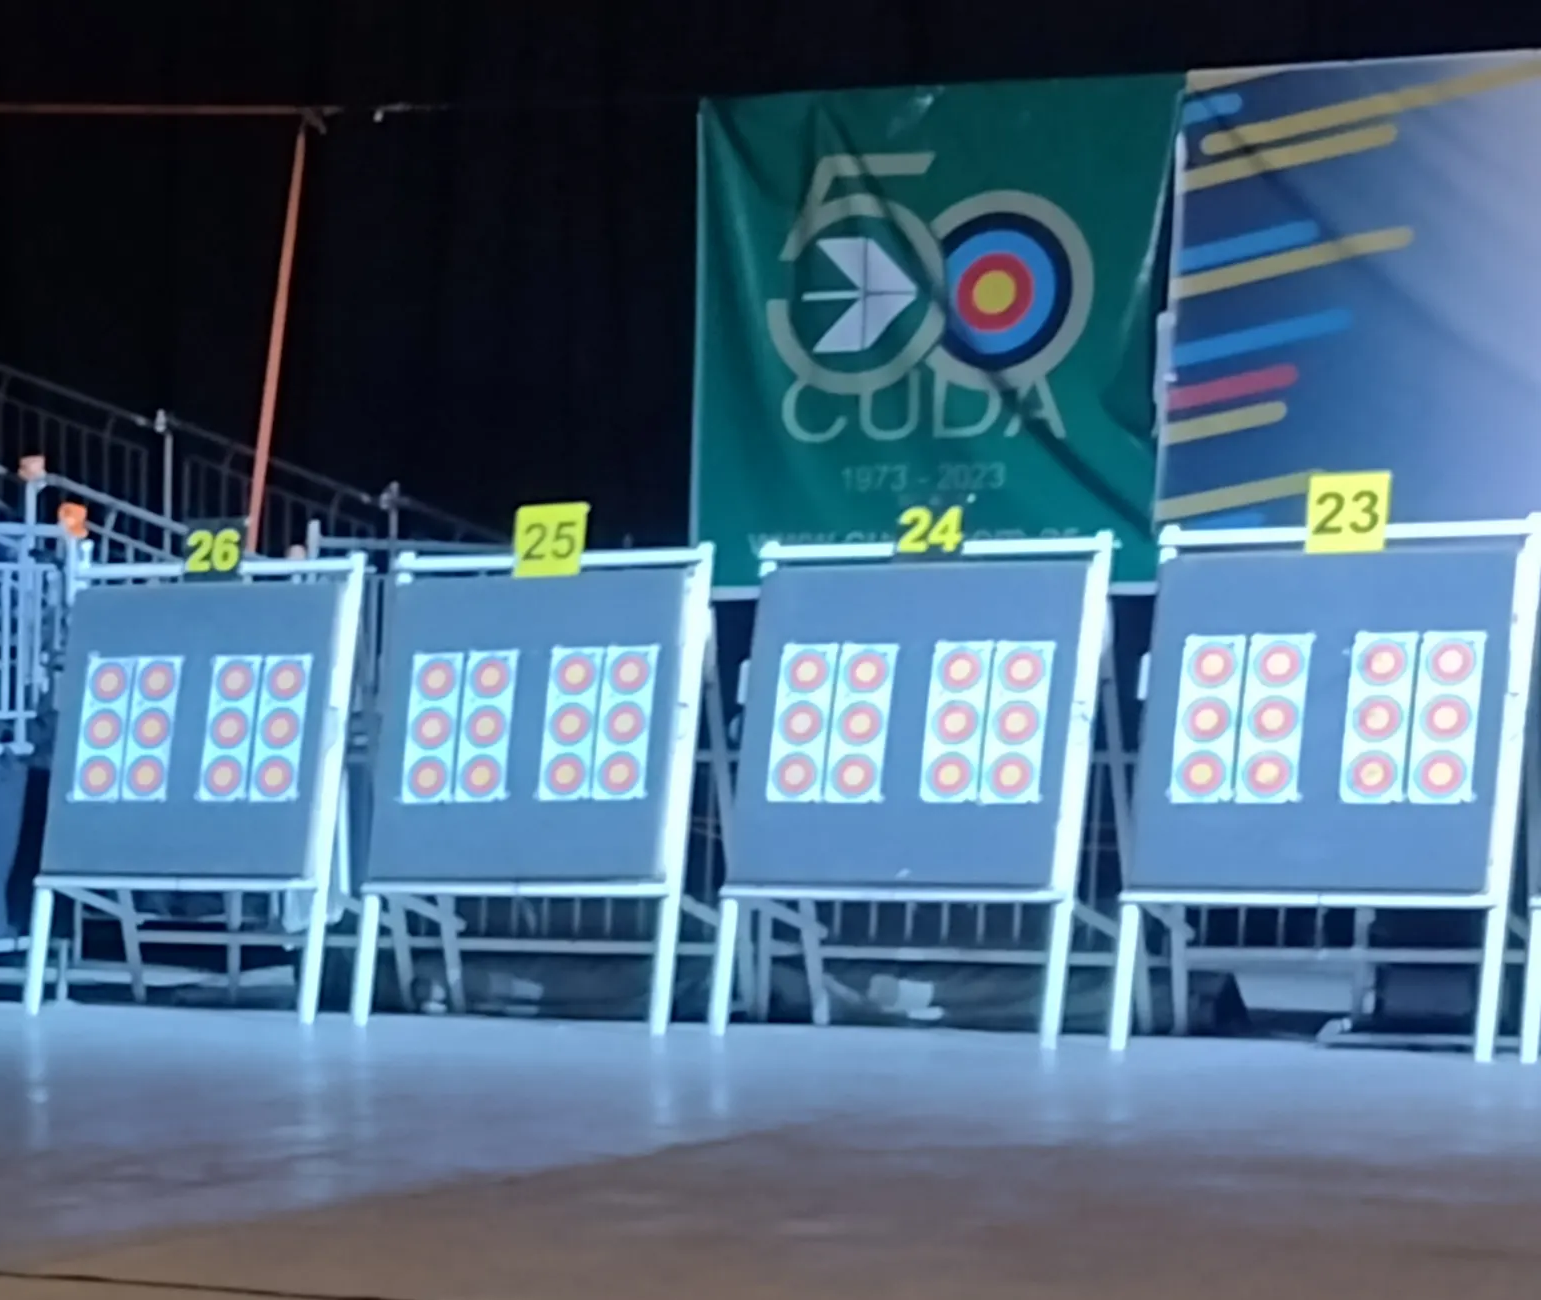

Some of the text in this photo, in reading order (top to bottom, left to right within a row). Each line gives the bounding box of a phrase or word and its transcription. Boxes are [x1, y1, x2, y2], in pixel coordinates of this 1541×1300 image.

[780, 367, 1066, 443] CUDA
[841, 463, 907, 491] 1973
[937, 462, 1006, 490] 2023
[897, 505, 963, 552] 24
[1312, 490, 1380, 535] 23
[185, 528, 241, 572] 26
[523, 521, 577, 560] 25
